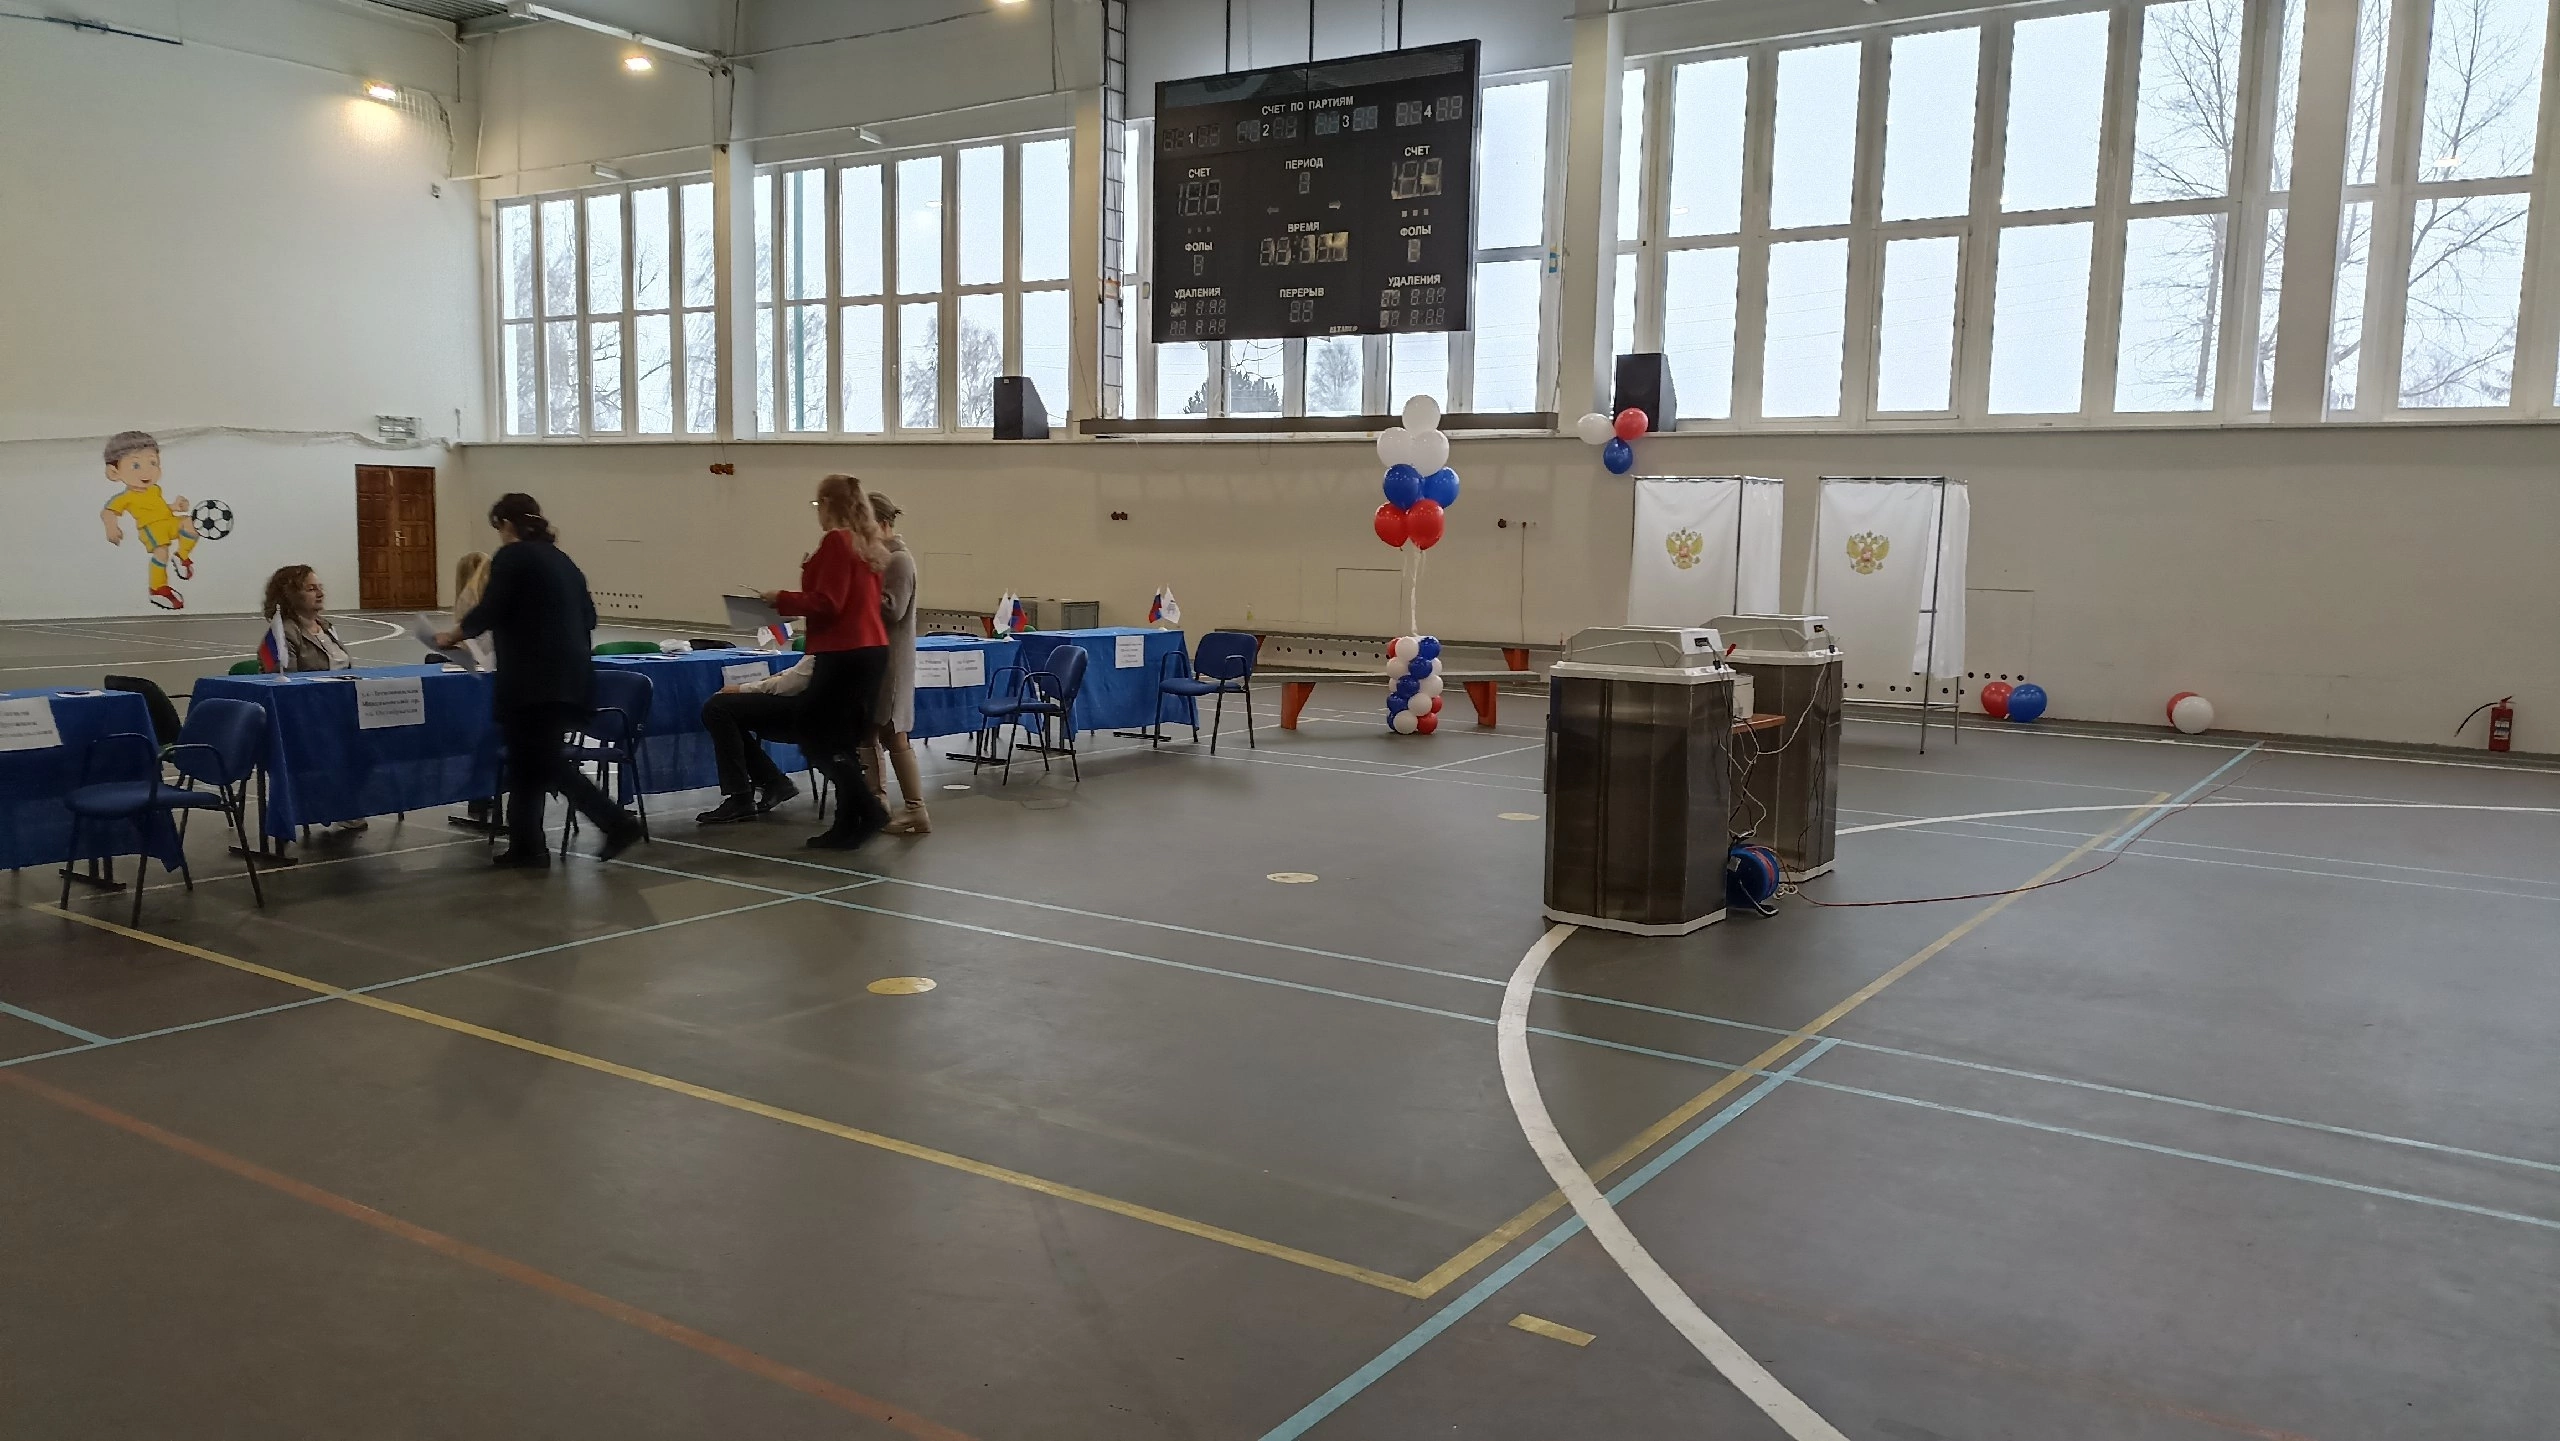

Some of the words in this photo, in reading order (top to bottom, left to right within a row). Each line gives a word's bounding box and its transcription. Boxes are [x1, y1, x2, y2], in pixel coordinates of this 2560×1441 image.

[1261, 104, 1286, 116] СЧЕТ
[1291, 102, 1304, 112] ПО
[1308, 95, 1354, 110] ПАРТИЯМ
[1423, 104, 1433, 118] 4
[1342, 114, 1350, 128] 3
[1262, 123, 1270, 137] 2
[1188, 132, 1194, 144] 1
[1404, 145, 1430, 157] СЧЕТ
[1285, 157, 1324, 170] ПЕРИОД
[1188, 167, 1212, 179] СЧЕТ
[1287, 221, 1320, 232] ВРЕМЯ
[1400, 225, 1432, 237] ФОЛЫ
[1388, 274, 1441, 288] УДАЛЕНИЯ
[1174, 287, 1221, 300] УДАЛЕНИЯ
[1279, 287, 1325, 298] ПЕРЕРЫВ
